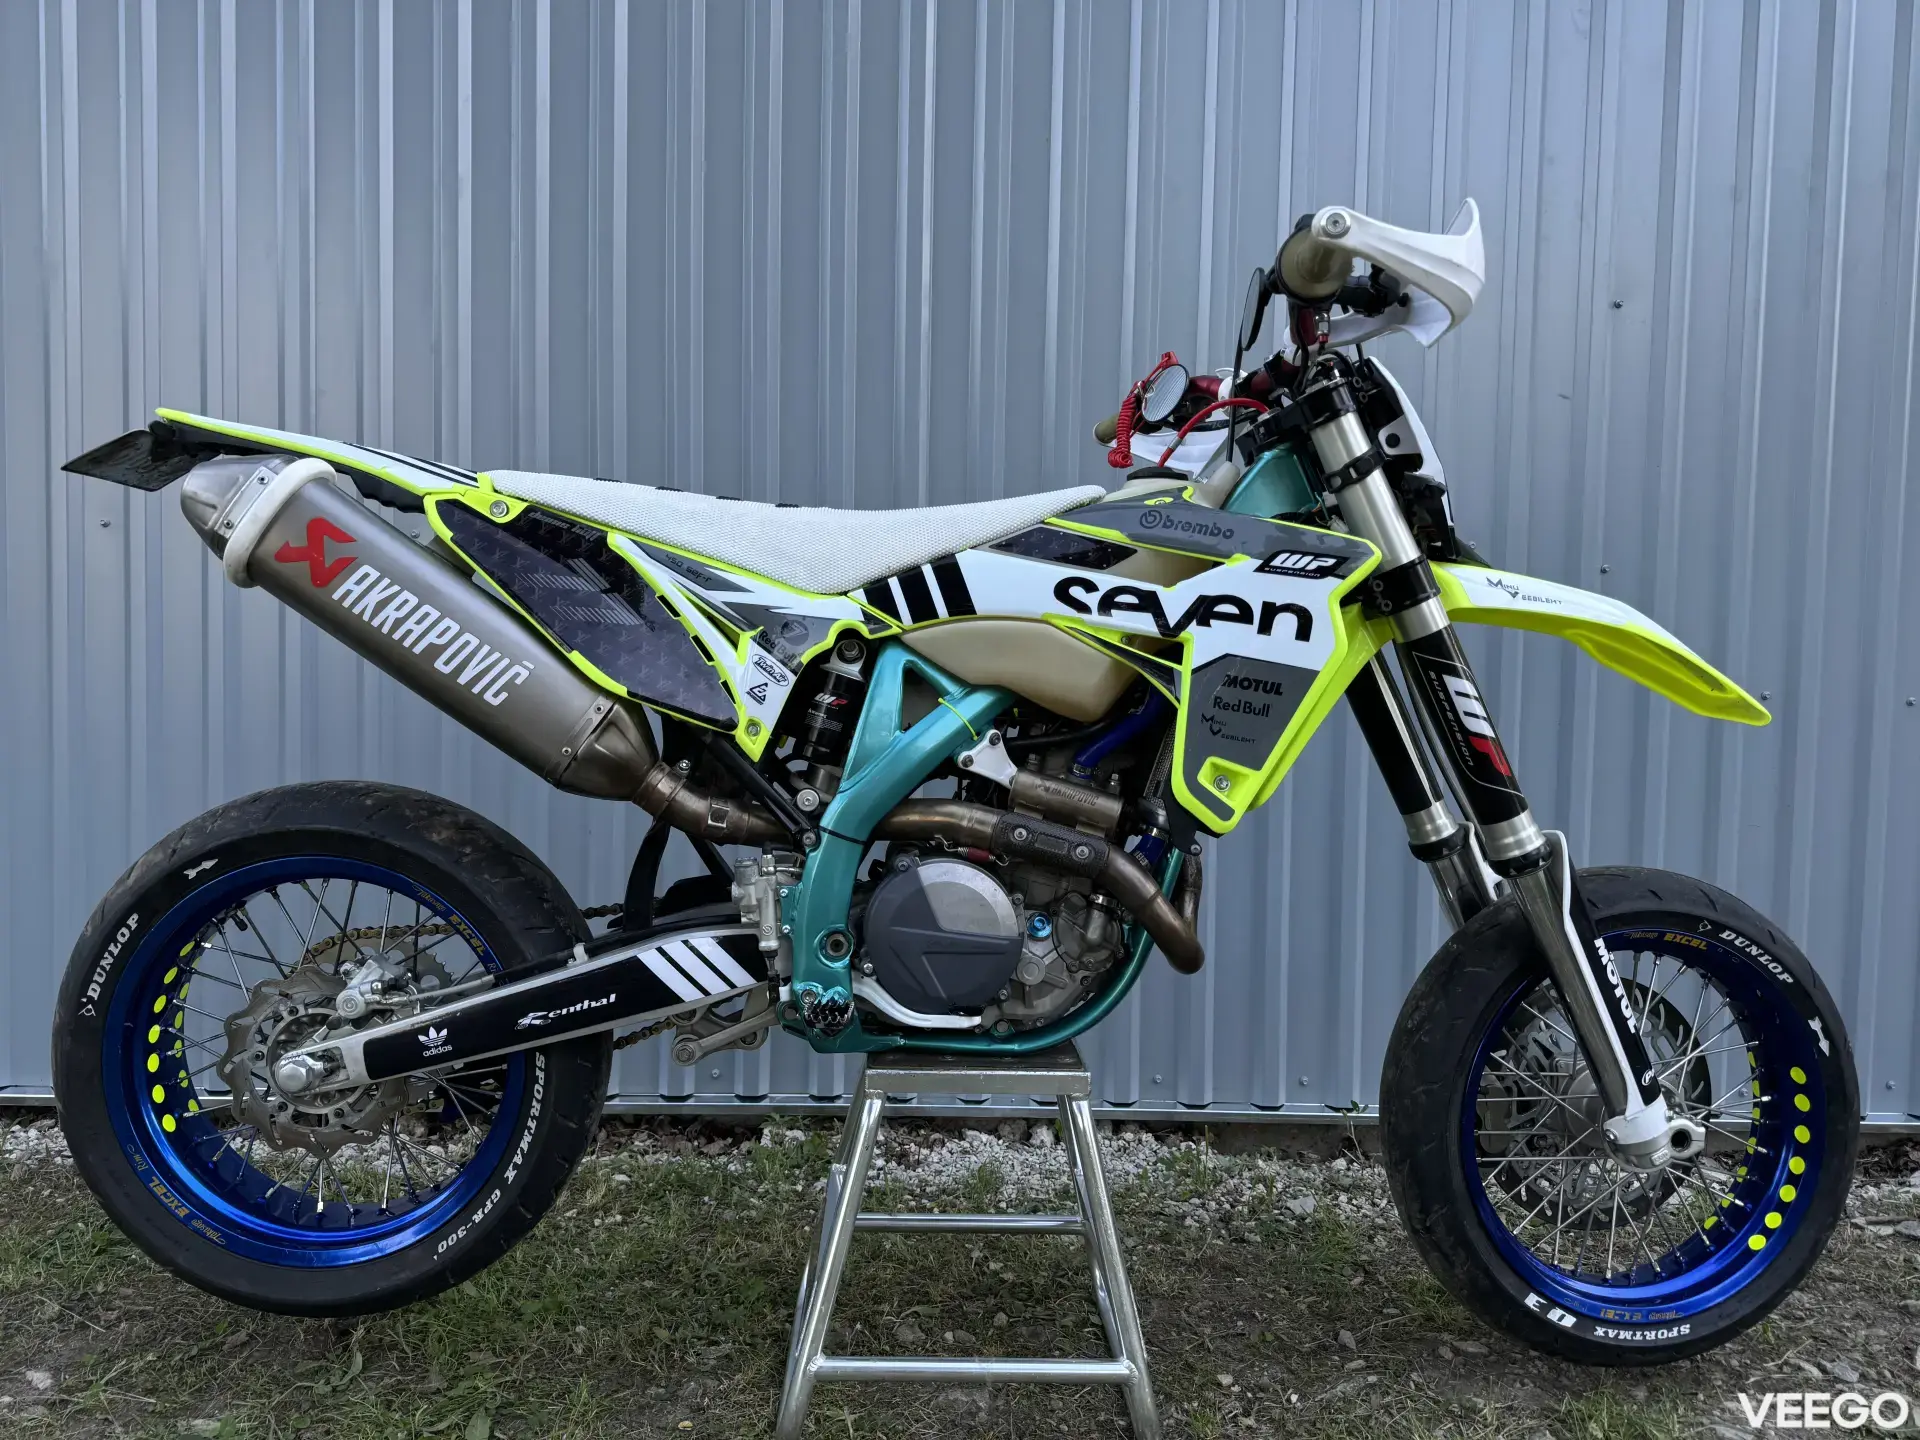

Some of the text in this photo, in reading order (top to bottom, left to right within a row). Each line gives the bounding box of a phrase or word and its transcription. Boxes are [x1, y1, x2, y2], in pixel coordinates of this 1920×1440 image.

[1162, 515, 1235, 540] brembo
[1269, 552, 1337, 571] WP
[1053, 576, 1314, 643] seven
[1221, 674, 1284, 696] MOTUL
[1213, 695, 1271, 718] Red Bull
[1441, 673, 1512, 777] WP
[448, 914, 486, 956] EXCEL
[1663, 932, 1708, 951] EXCEL
[86, 912, 140, 1001] DUNLOP
[1718, 929, 1795, 984] DUNLOP
[514, 993, 617, 1031] Renthal
[422, 1045, 453, 1057] adidas
[504, 1051, 546, 1185] SPORTMAX
[148, 1176, 191, 1218] EXCEL
[1593, 1323, 1692, 1341] SPORTMAX
